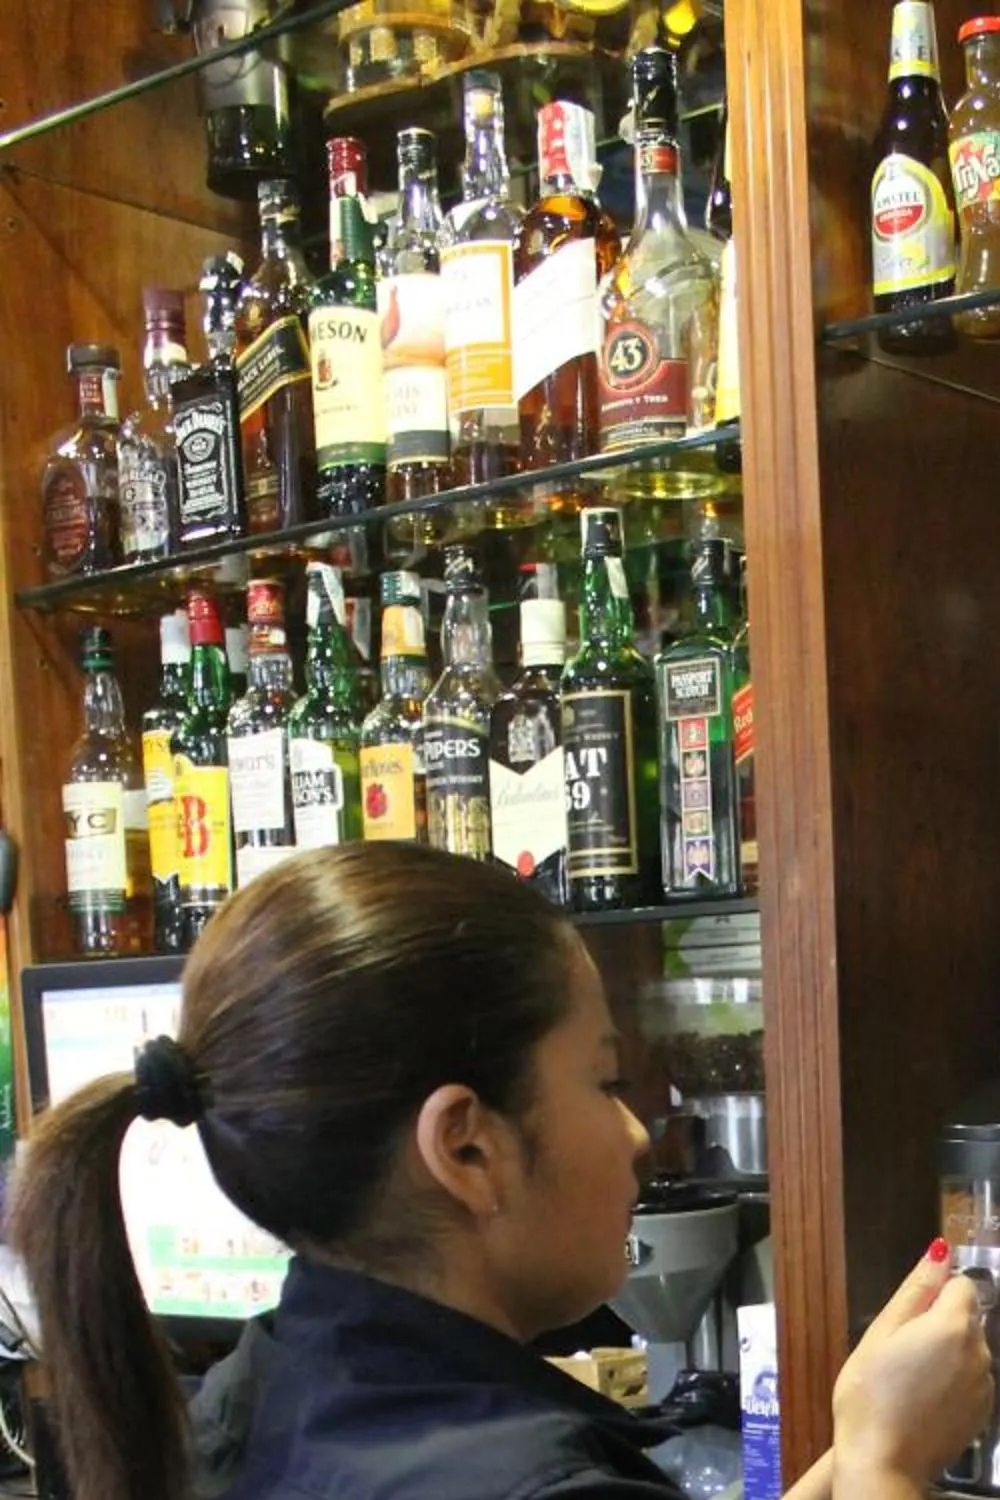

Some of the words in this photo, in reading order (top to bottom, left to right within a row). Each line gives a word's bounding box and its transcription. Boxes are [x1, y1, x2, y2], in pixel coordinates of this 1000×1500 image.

[609, 337, 643, 371] 43
[565, 747, 607, 781] AT
[66, 812, 108, 833] YC
